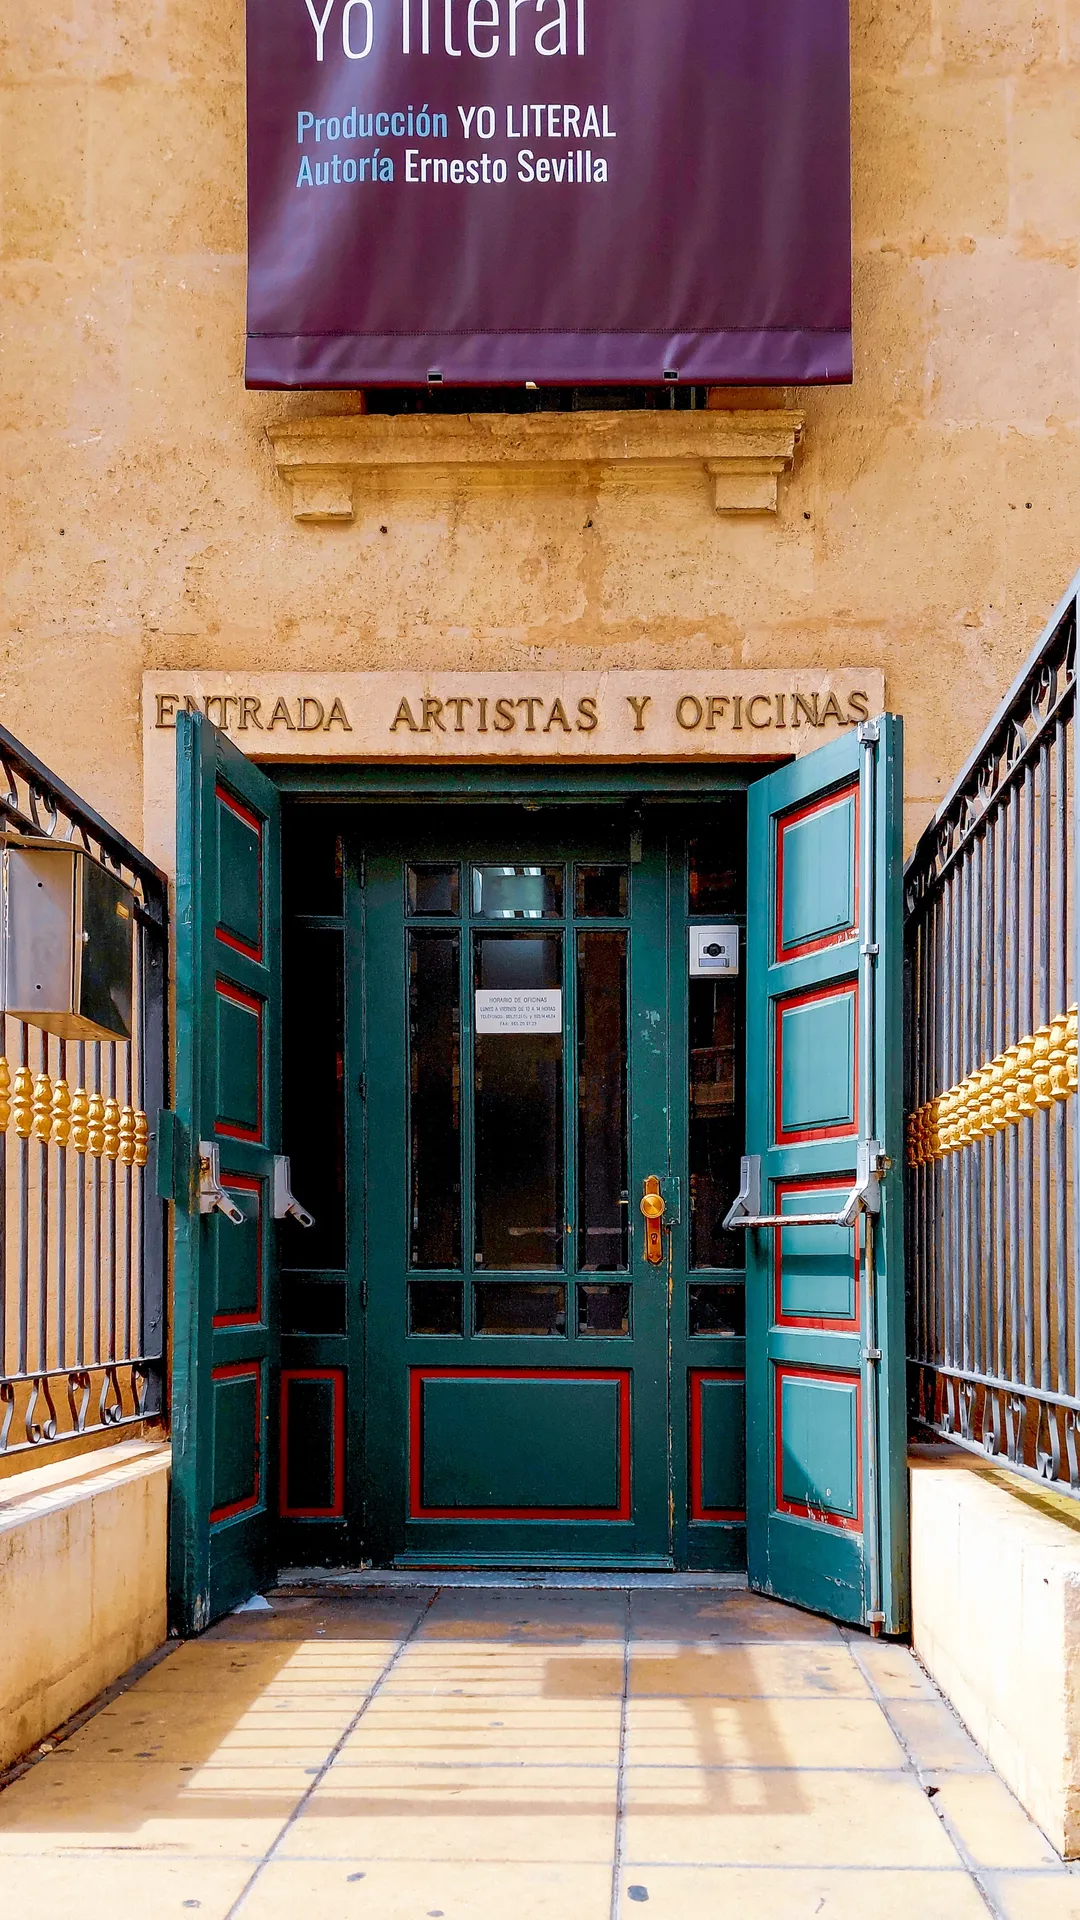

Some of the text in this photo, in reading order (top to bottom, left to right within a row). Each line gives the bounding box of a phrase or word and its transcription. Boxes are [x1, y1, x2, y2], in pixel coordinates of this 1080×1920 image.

[305, 0, 586, 61] Yo literal
[297, 104, 617, 143] Producción YO LITERAL
[296, 148, 608, 188] Autoría Ernesto Sevilla
[389, 696, 599, 731] ARTISTAS
[626, 695, 652, 731] Y
[675, 690, 869, 730] OFICINAS
